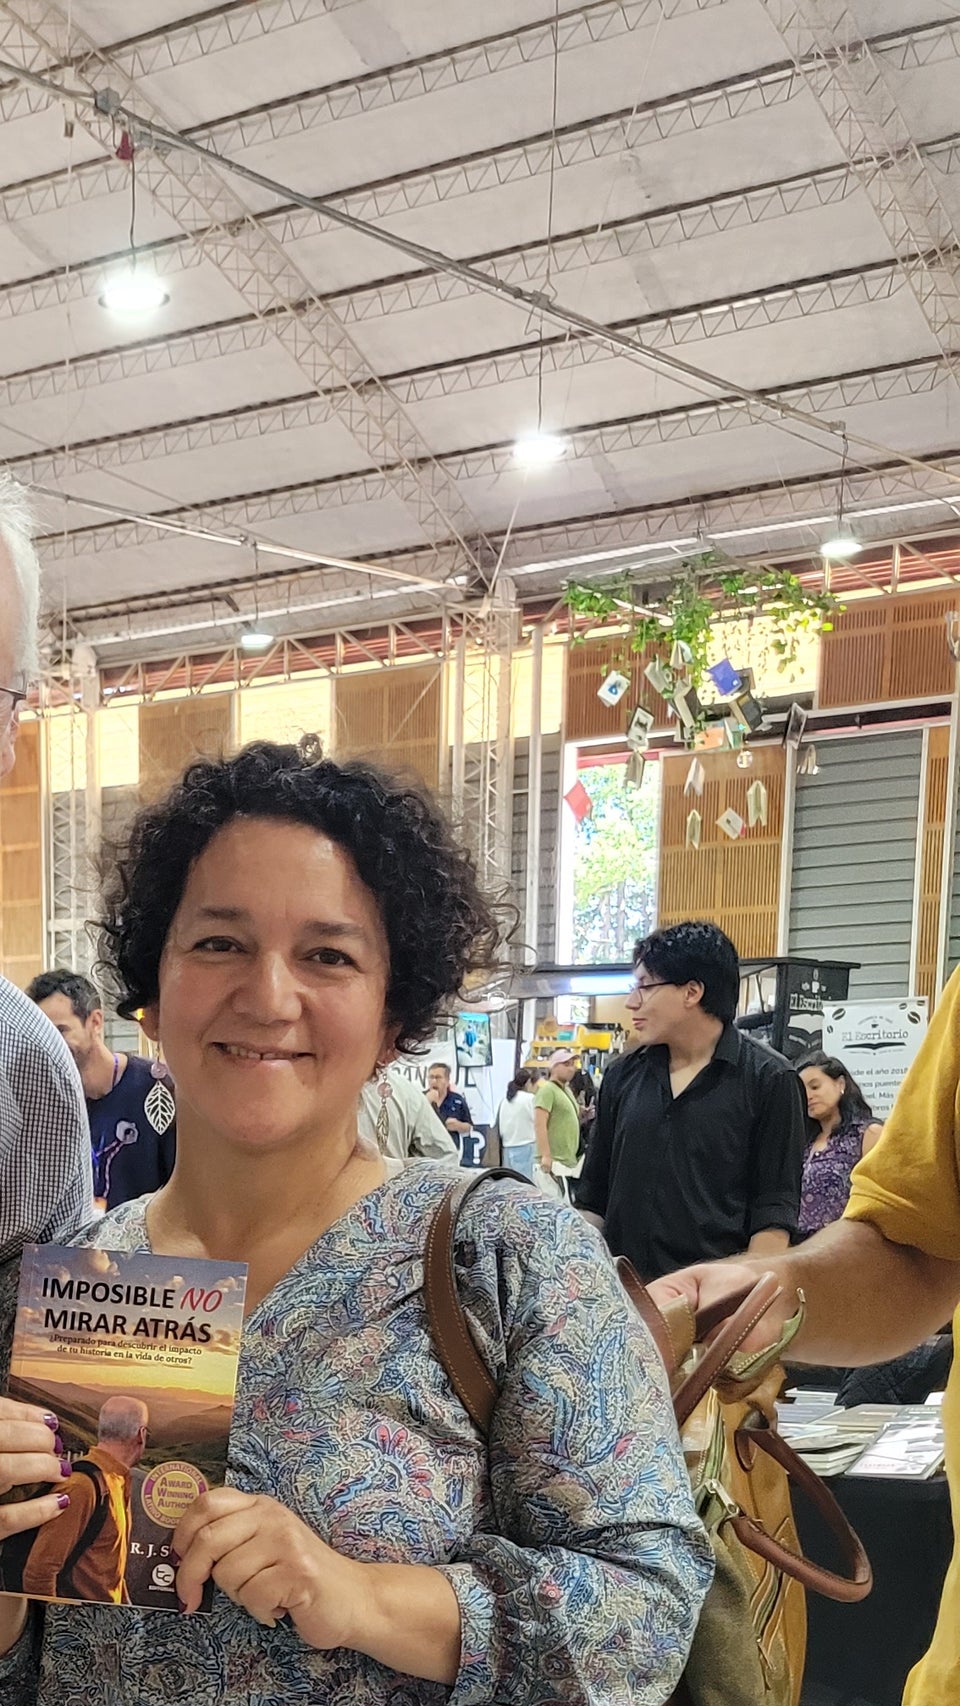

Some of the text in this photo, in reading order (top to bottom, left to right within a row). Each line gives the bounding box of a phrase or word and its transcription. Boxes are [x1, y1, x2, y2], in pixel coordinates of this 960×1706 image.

[855, 1028, 909, 1041] Escritorio
[42, 1277, 223, 1313] IMPOSIBLE NO
[44, 1308, 212, 1344] MIRAR ATRÁS
[57, 1345, 68, 1353] de
[69, 1346, 78, 1354] tu
[80, 1346, 112, 1357] historia
[126, 1350, 133, 1358] la
[135, 1352, 152, 1360] vida
[154, 1353, 164, 1362] de
[166, 1354, 192, 1365] otros?
[98, 1339, 116, 1349] para
[118, 1340, 157, 1352] descubrir
[159, 1343, 167, 1352] el
[168, 1345, 202, 1356] impacto
[130, 1542, 157, 1558] R. J.
